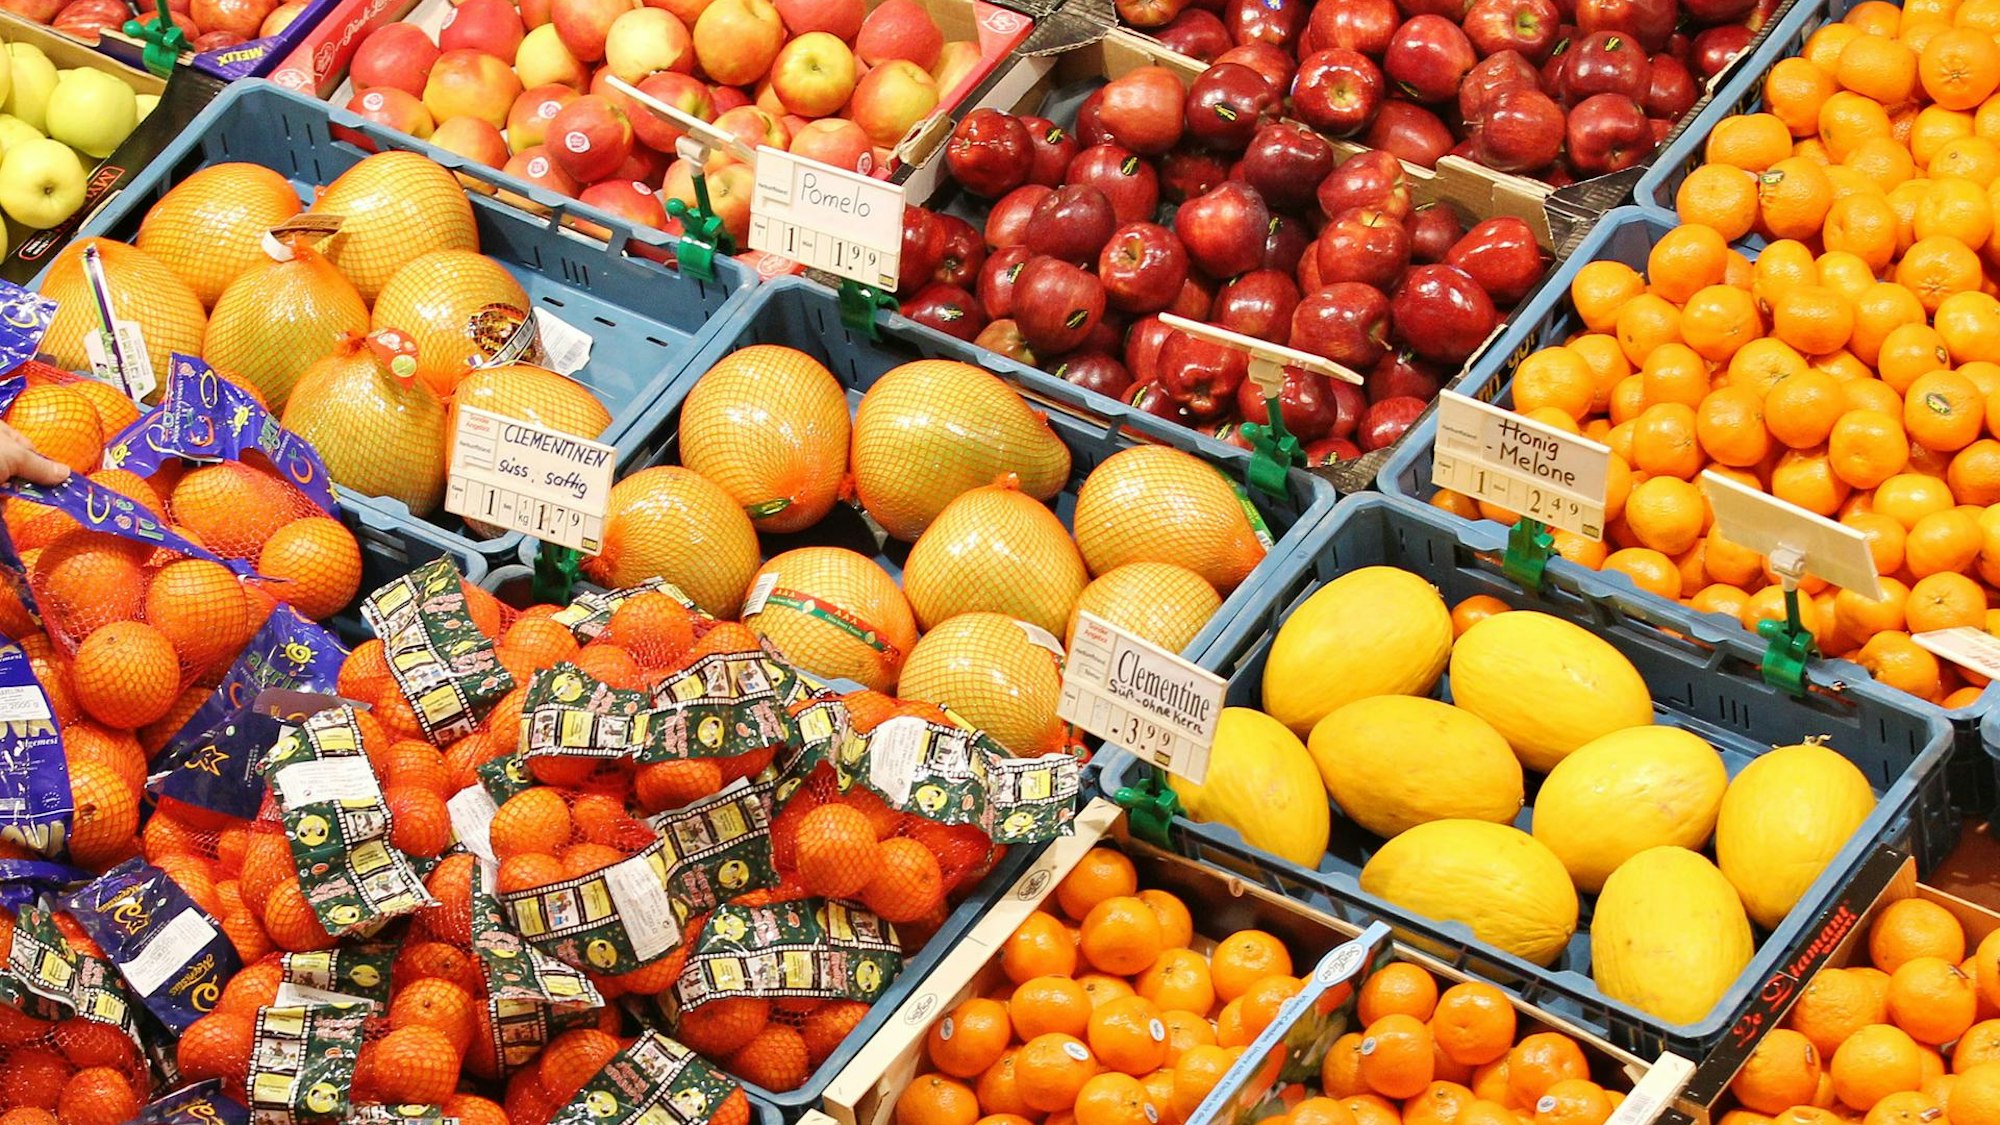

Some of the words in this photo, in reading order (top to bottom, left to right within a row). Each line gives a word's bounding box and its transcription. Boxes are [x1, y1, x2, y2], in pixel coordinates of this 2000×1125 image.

[216, 47, 265, 67] MELIX
[800, 172, 871, 218] Pomelo
[786, 227, 795, 253] 1
[836, 241, 877, 271] 1.99
[504, 423, 610, 468] CLEMENTINEN
[1498, 418, 1560, 461] Honig
[544, 471, 589, 500] saftig
[1499, 442, 1577, 487] Melone
[486, 489, 496, 516] 1
[536, 504, 581, 535] 1.79
[1475, 470, 1487, 495] 1
[1529, 490, 1580, 519] 2.49
[518, 512, 530, 526] kg
[1118, 649, 1211, 723] Clementine
[1761, 905, 1850, 1013] Diamant
